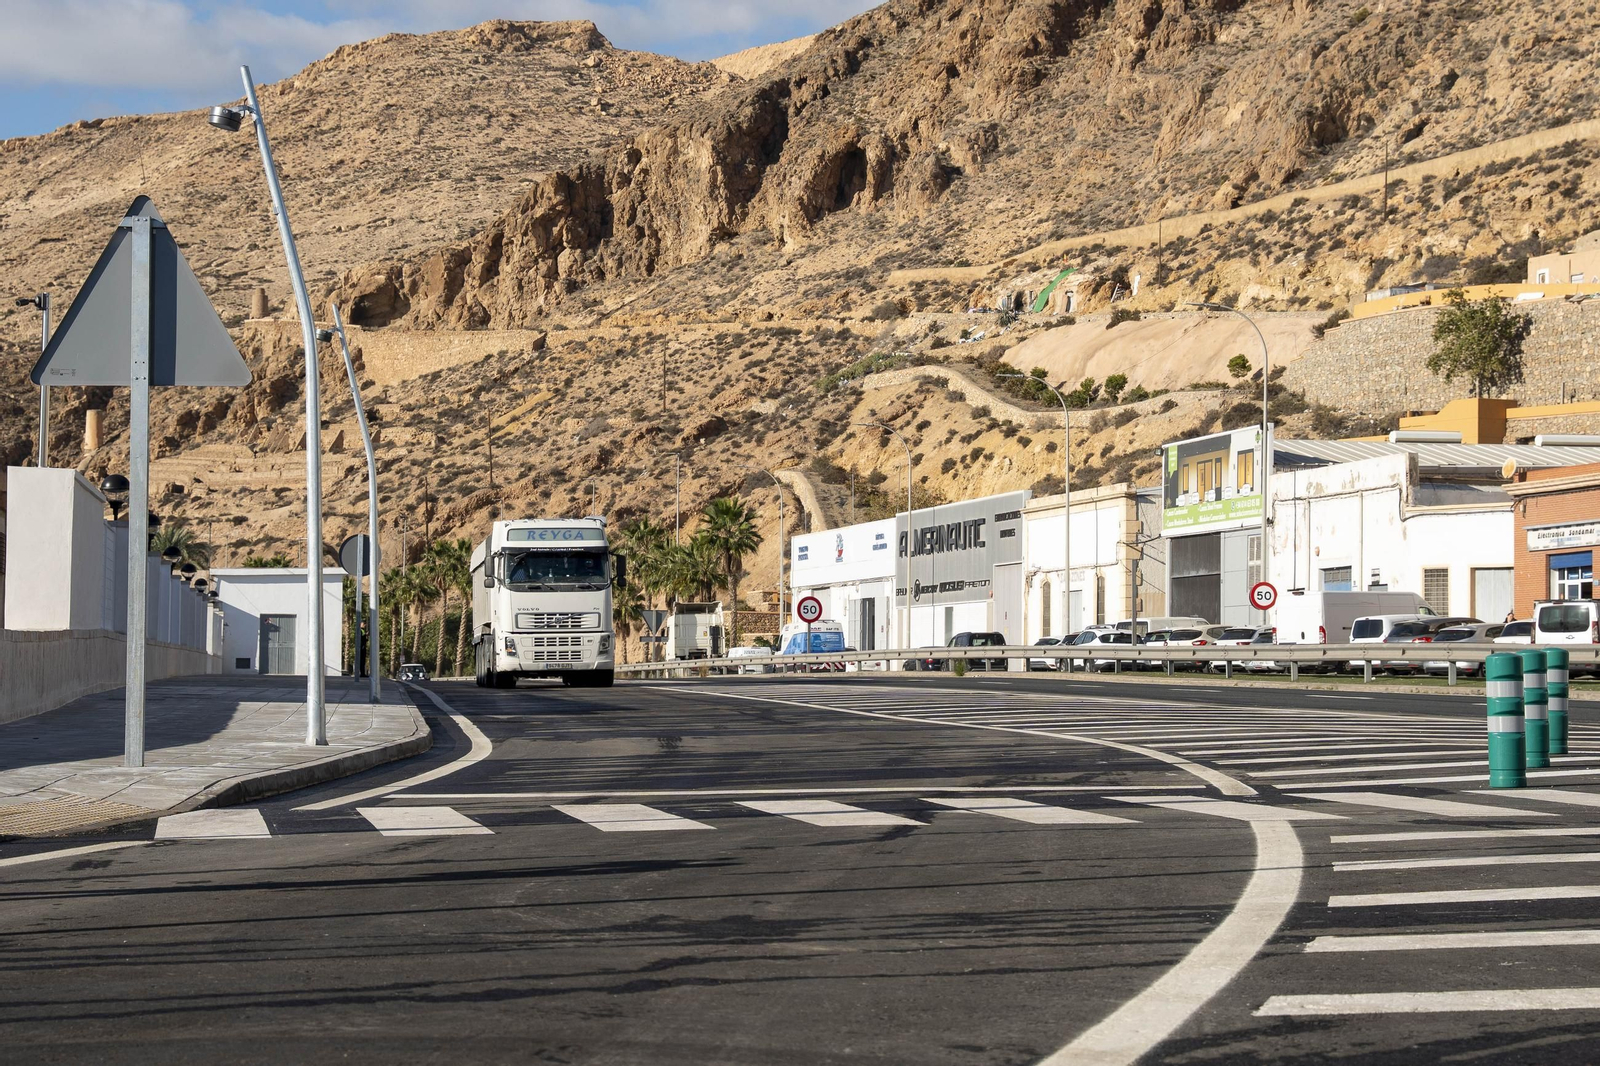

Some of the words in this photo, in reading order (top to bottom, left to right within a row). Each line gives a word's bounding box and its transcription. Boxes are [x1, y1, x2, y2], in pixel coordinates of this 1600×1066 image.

[527, 530, 584, 540] REYGA
[1257, 591, 1271, 600] 50
[803, 605, 817, 614] 50
